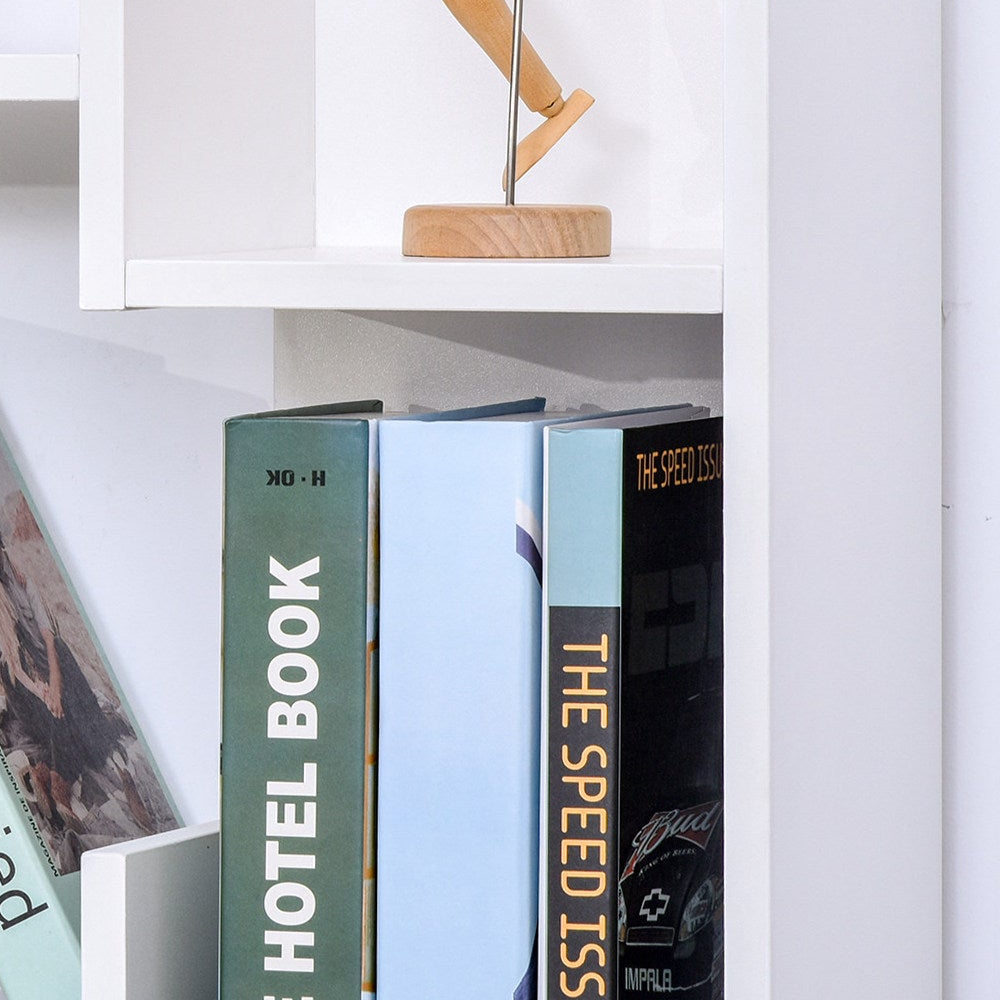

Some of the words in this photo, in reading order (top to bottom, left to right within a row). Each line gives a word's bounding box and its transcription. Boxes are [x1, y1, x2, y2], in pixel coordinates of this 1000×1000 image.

[637, 451, 658, 491] THE
[661, 446, 695, 488] SPEED
[266, 556, 321, 740] BOOK
[562, 634, 608, 729] THE
[20, 799, 29, 813] DE
[560, 745, 608, 897] SPEED
[632, 803, 716, 856] Bud
[29, 818, 59, 877] MAGAZINE
[264, 762, 318, 973] HOTEL
[624, 967, 672, 992] IMPALA
